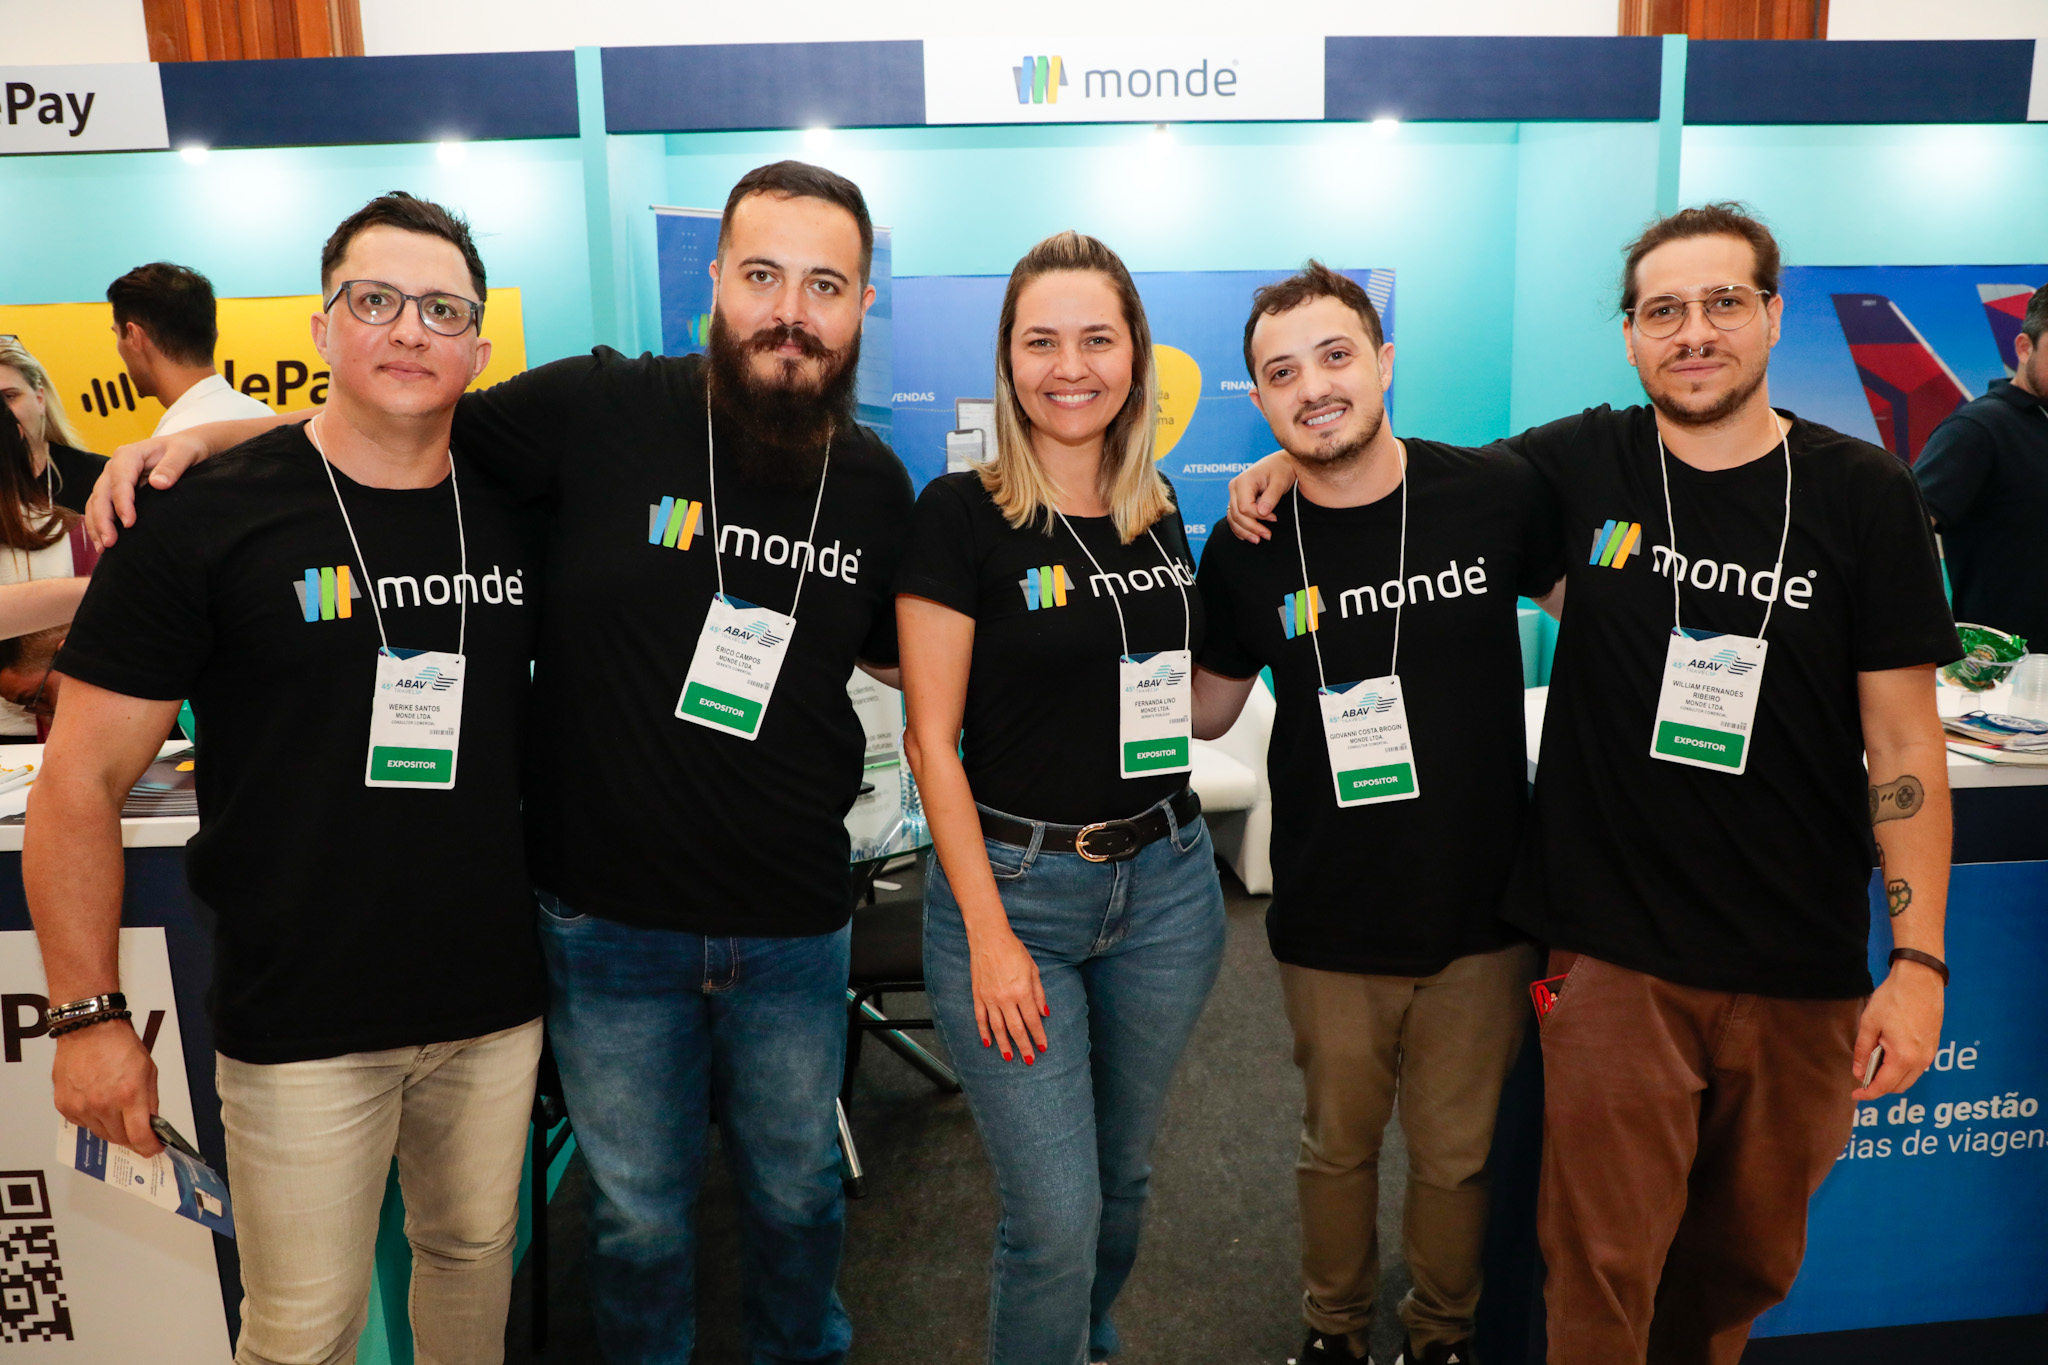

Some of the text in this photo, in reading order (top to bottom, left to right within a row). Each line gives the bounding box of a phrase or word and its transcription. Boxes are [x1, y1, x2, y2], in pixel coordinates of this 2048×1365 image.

[1085, 59, 1237, 98] monde
[0, 82, 96, 138] Pay
[1221, 381, 1256, 391] FINAN
[1183, 463, 1254, 475] ATENDIMENT
[719, 525, 859, 584] monde
[1652, 545, 1813, 610] monde
[377, 565, 524, 609] monde
[1339, 560, 1488, 619] monde
[723, 626, 754, 640] ABAV
[716, 645, 761, 665] ÉRICO CAMPOS
[719, 655, 738, 665] MONDE
[1688, 659, 1723, 671] ABAV
[396, 679, 427, 689] ABAV
[1137, 679, 1162, 688] ABAV
[1672, 680, 1744, 698] WILLIAM FERNANDES
[1135, 699, 1163, 707] FERNANDA
[1693, 692, 1720, 702] RIBEIRO
[699, 697, 745, 718] EXPOSITOR
[1685, 699, 1707, 709] MONDE
[1342, 707, 1370, 718] ABAV
[1330, 731, 1357, 740] GIOVANNI
[1358, 727, 1378, 736] COSTA
[1674, 736, 1726, 752] EXPOSITOR
[1137, 749, 1176, 759] EXPOSITOR
[387, 760, 436, 769] EXPOSITOR
[1353, 776, 1398, 788] EXPOSITOR
[1887, 1098, 1926, 1125] de
[1934, 1092, 2039, 1129] gestão
[1901, 1129, 1938, 1156] de
